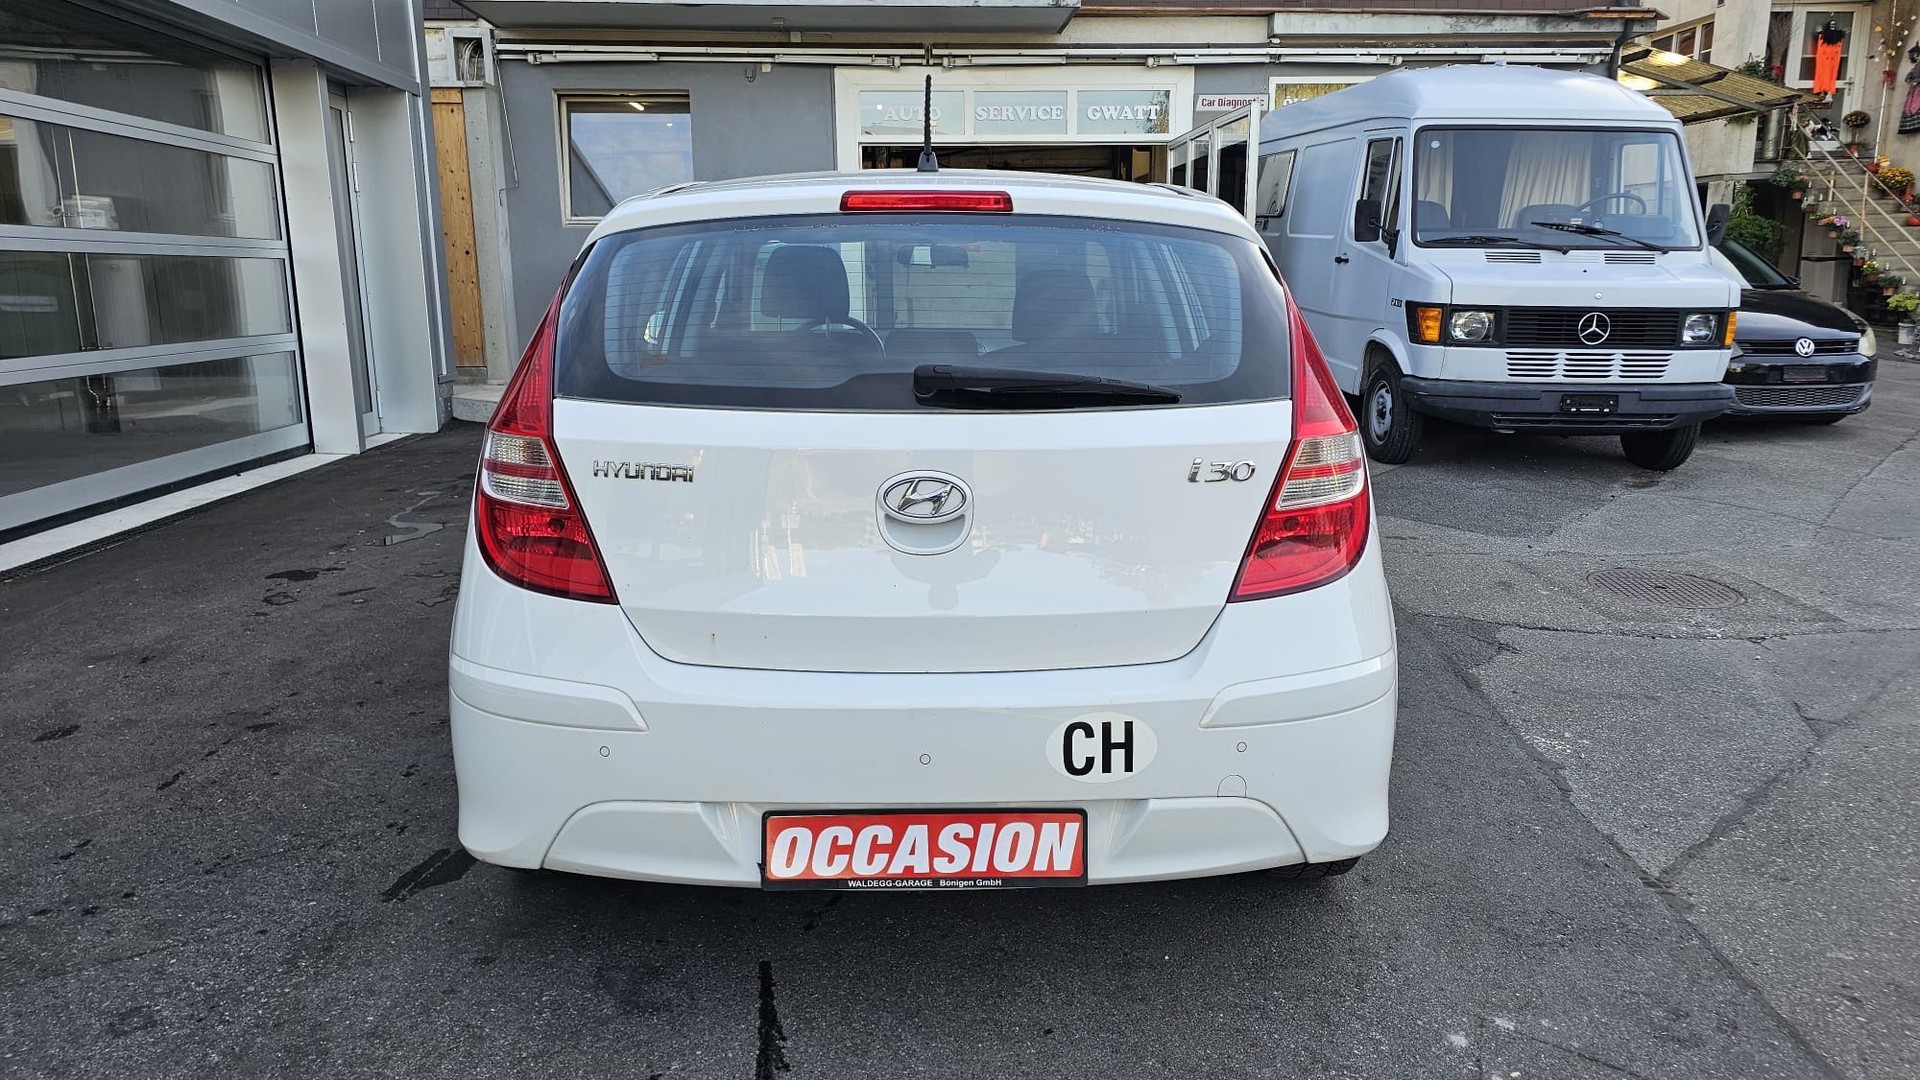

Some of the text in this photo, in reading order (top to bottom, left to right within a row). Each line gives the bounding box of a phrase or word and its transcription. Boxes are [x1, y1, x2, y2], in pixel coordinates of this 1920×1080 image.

[883, 104, 1160, 121] AUTO SERVICE GWATT
[1201, 98, 1216, 107] Car
[593, 460, 694, 482] HYUNDAI
[1187, 456, 1256, 483] i30
[1062, 720, 1134, 777] CH
[769, 821, 1080, 879] OCCASION
[847, 878, 1002, 889] WALDEGG-GARAGE Bönigen GmbH
